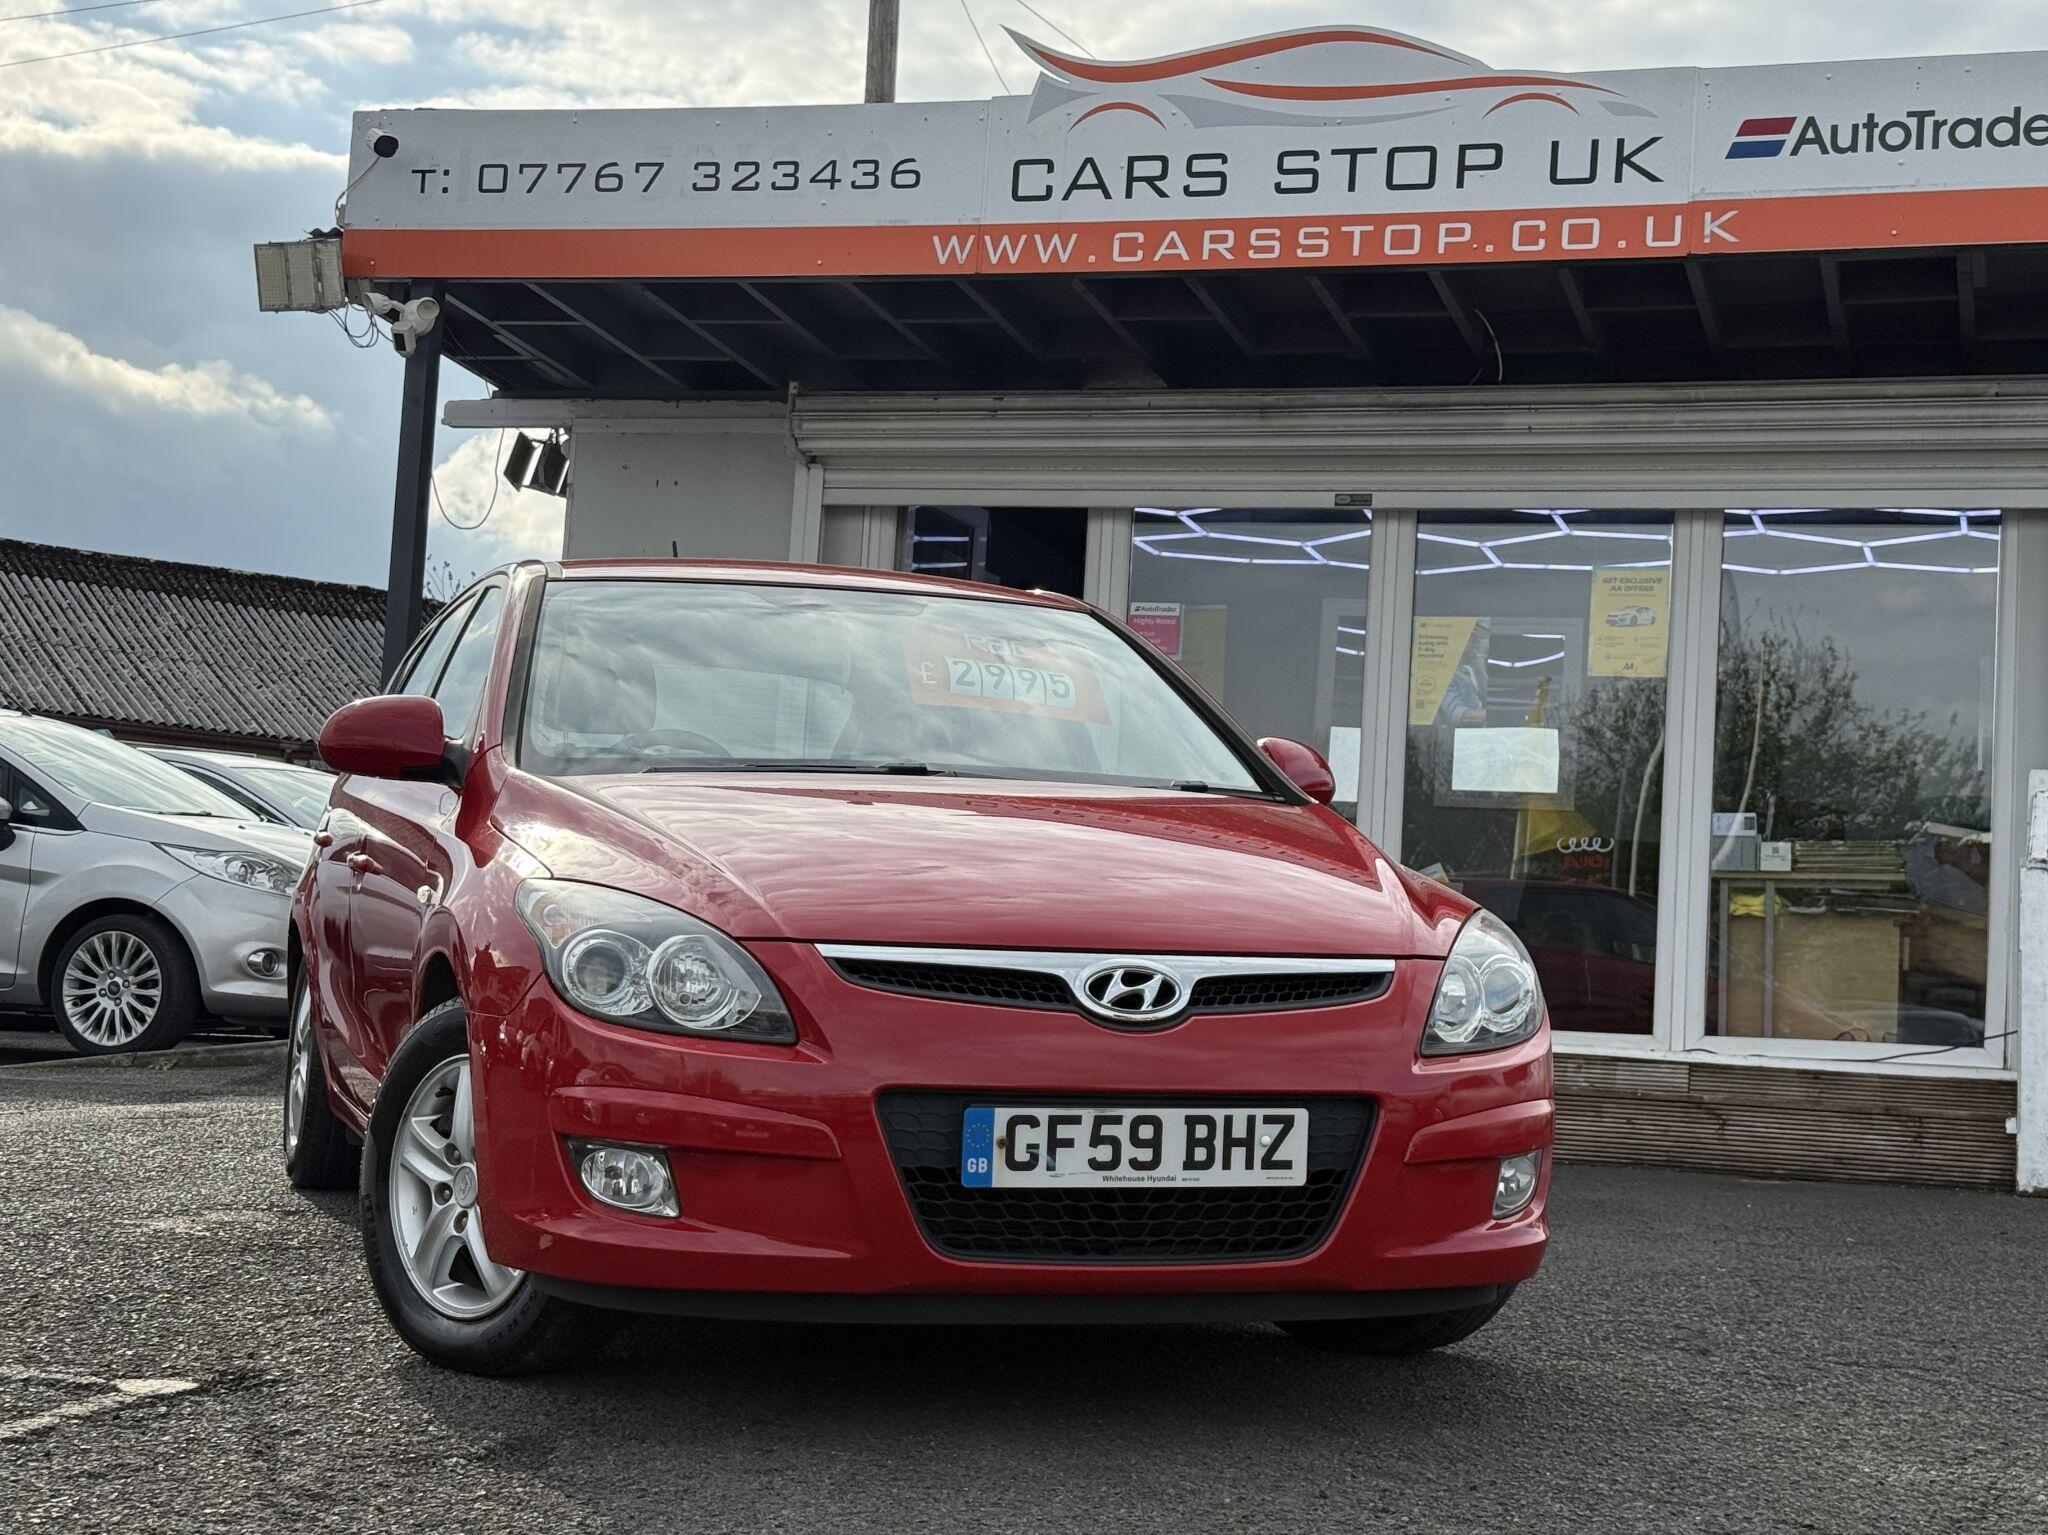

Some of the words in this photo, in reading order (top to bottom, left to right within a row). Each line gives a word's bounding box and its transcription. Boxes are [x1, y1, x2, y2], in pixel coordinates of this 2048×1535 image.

[411, 167, 450, 194] T:
[477, 162, 665, 195] 07767
[692, 157, 923, 192] 323436
[1011, 152, 1228, 202] CARS
[1274, 143, 1504, 195] STOP
[1550, 136, 1665, 186] UK
[1133, 617, 1155, 625] Highly
[1156, 617, 1176, 625] Rated
[1140, 605, 1177, 613] AutoTrader
[953, 660, 1071, 699] 2995
[1004, 1114, 1164, 1172] GF59
[1183, 1114, 1296, 1172] BHZ
[967, 1158, 988, 1174] GB
[1147, 1175, 1177, 1184] Hyundai
